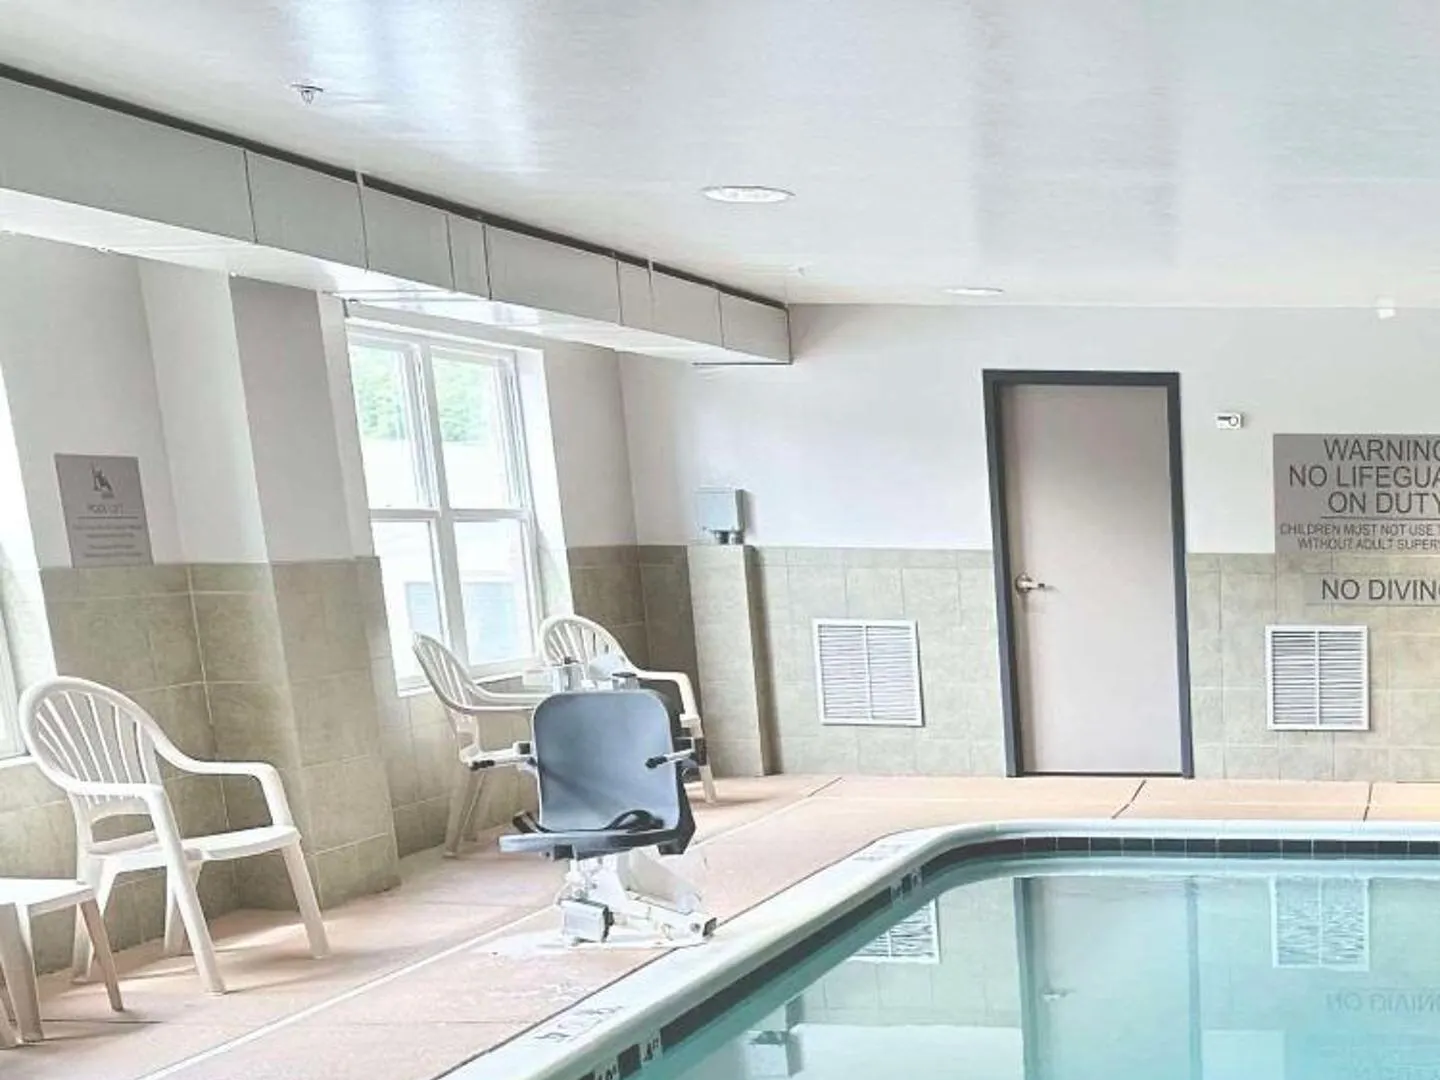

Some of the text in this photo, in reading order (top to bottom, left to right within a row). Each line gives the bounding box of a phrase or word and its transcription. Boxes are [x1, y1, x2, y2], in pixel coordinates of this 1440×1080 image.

[1289, 464, 1328, 488] NO
[1328, 491, 1367, 514] ON
[1280, 522, 1341, 536] CHILDREN
[1343, 523, 1377, 536] MUST
[1380, 523, 1406, 537] NOT
[1408, 523, 1434, 537] USE
[1297, 538, 1353, 551] WITHOUT
[1356, 538, 1393, 551] ADULT
[1321, 578, 1360, 601] NO
